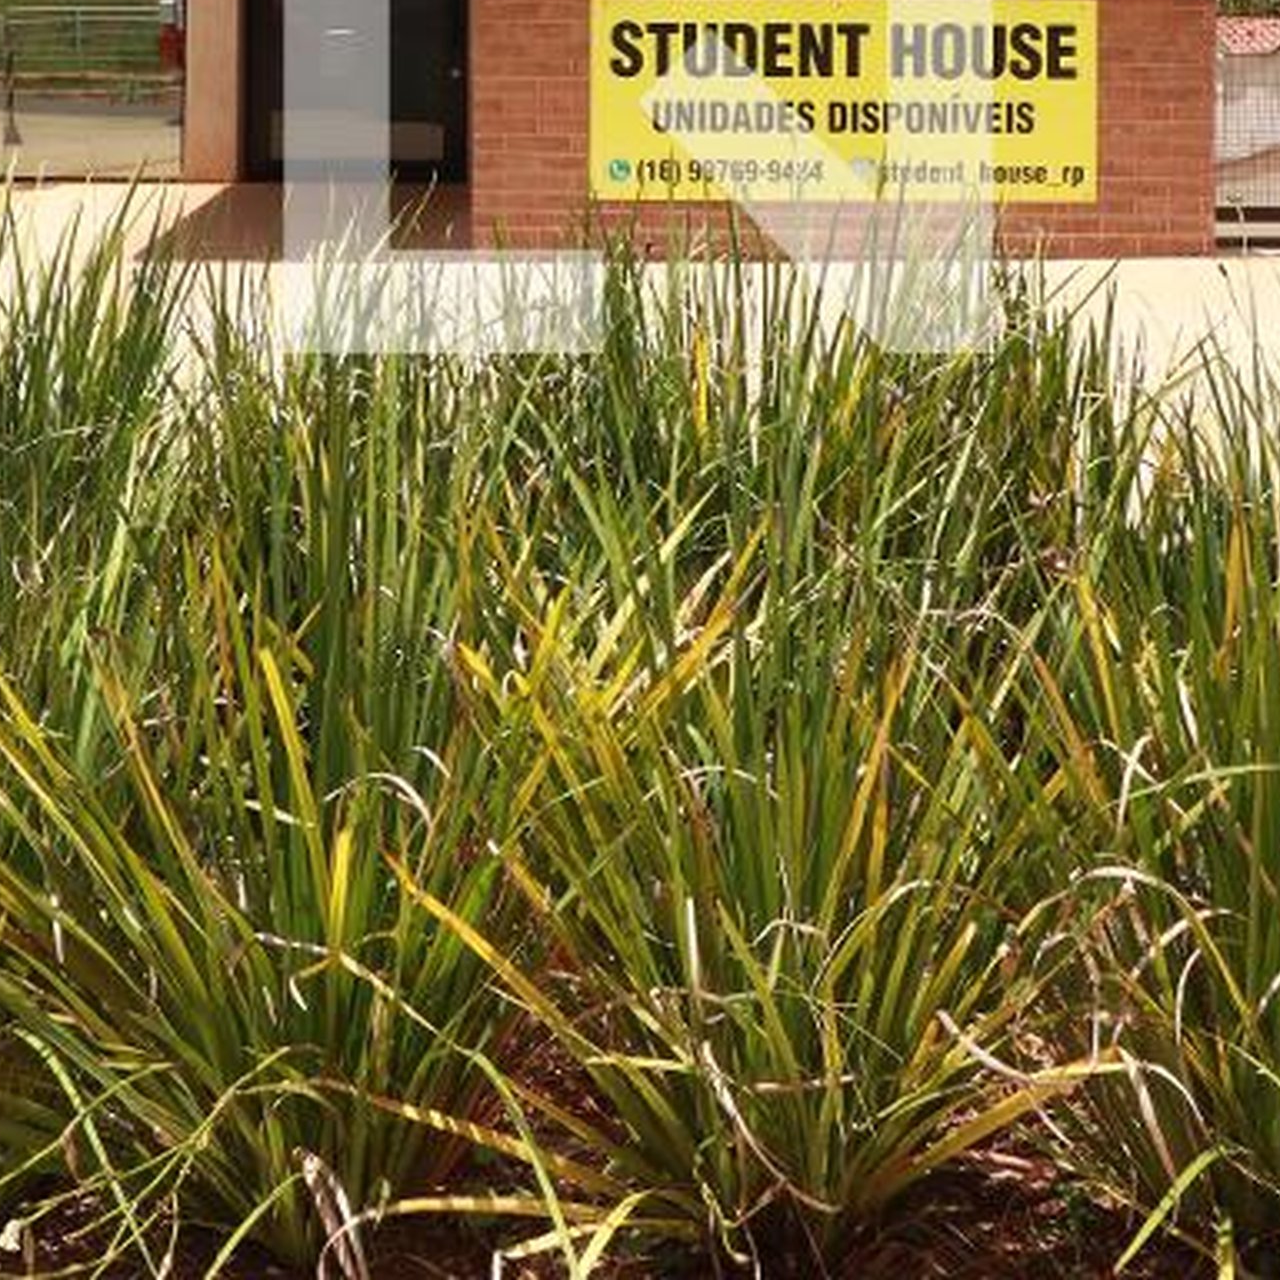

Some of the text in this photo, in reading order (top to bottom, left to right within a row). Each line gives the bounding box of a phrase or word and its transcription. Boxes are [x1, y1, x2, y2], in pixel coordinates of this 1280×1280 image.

[609, 19, 1079, 81] STUDENT HOUSE
[651, 92, 1036, 135] UNIDADES DISPONÍVEIS
